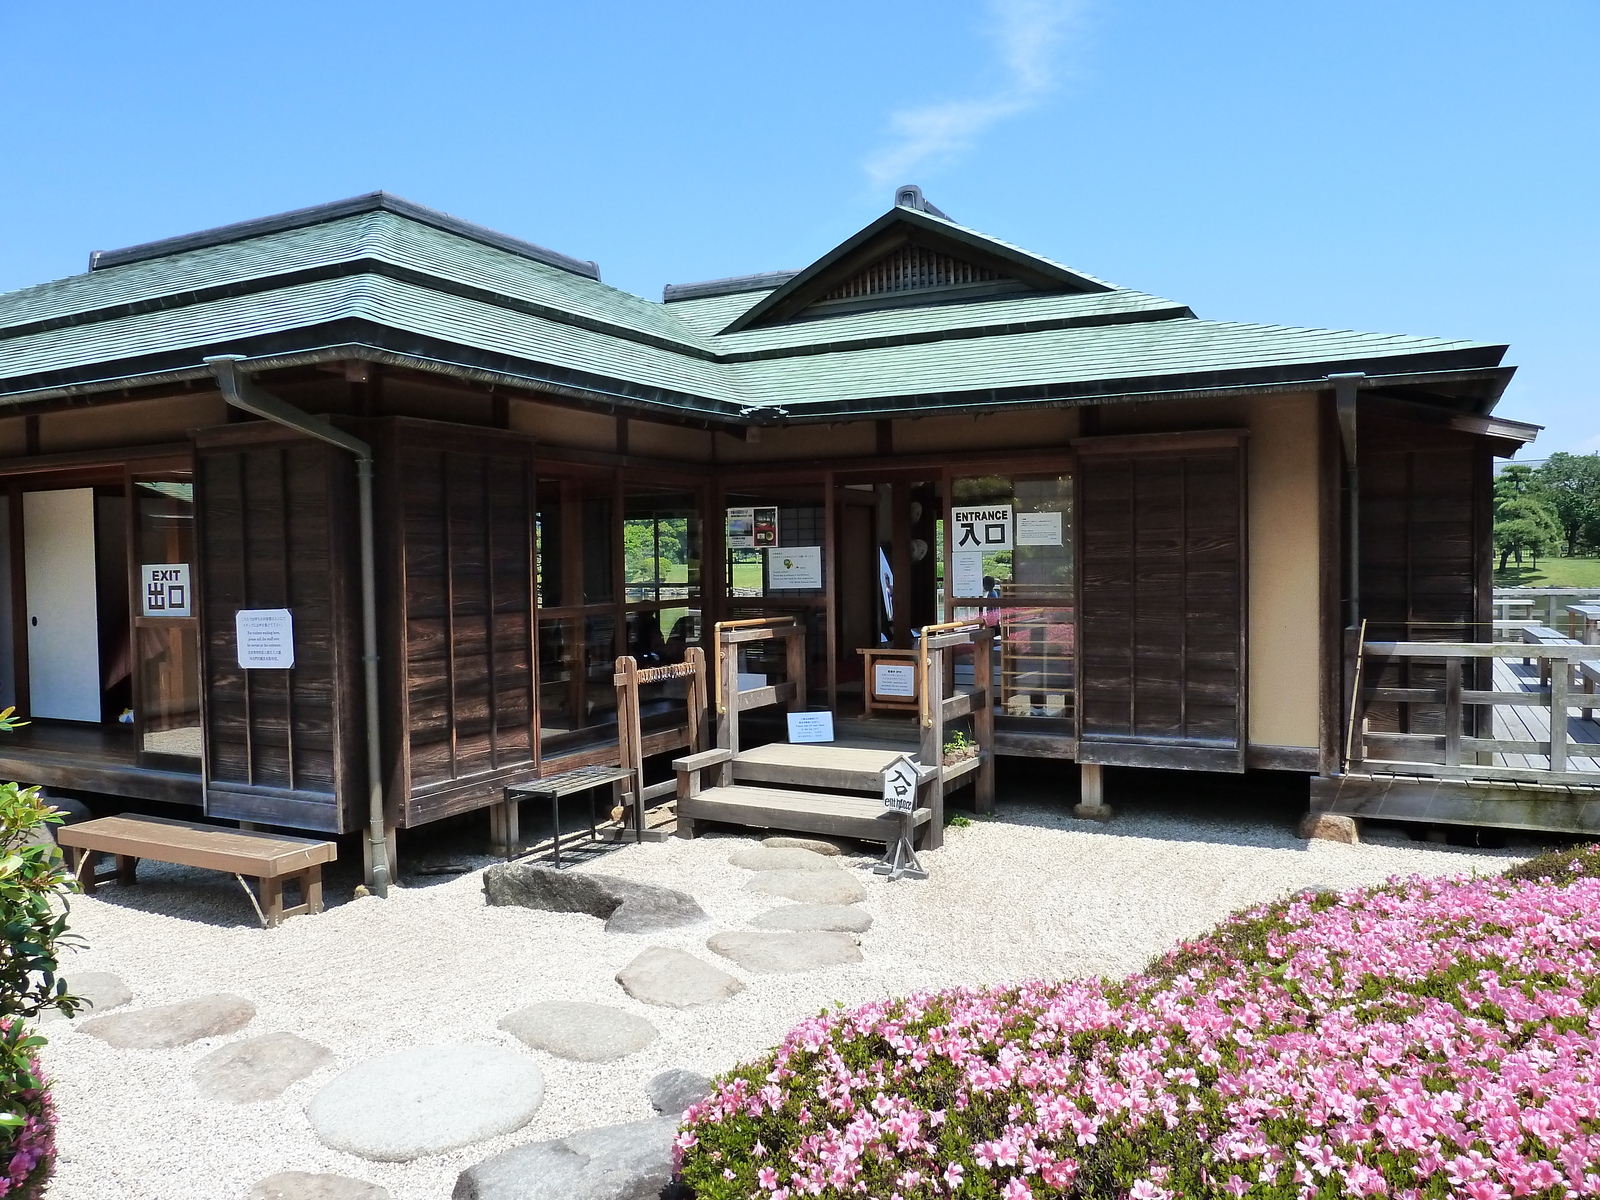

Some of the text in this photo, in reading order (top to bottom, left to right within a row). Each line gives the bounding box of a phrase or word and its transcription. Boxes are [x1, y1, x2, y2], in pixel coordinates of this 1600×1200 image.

[956, 510, 1008, 522] ENTRANCE
[958, 523, 1006, 547] 入口
[152, 570, 180, 581] EXIT
[148, 582, 185, 610] 出口
[887, 770, 912, 797] 入口
